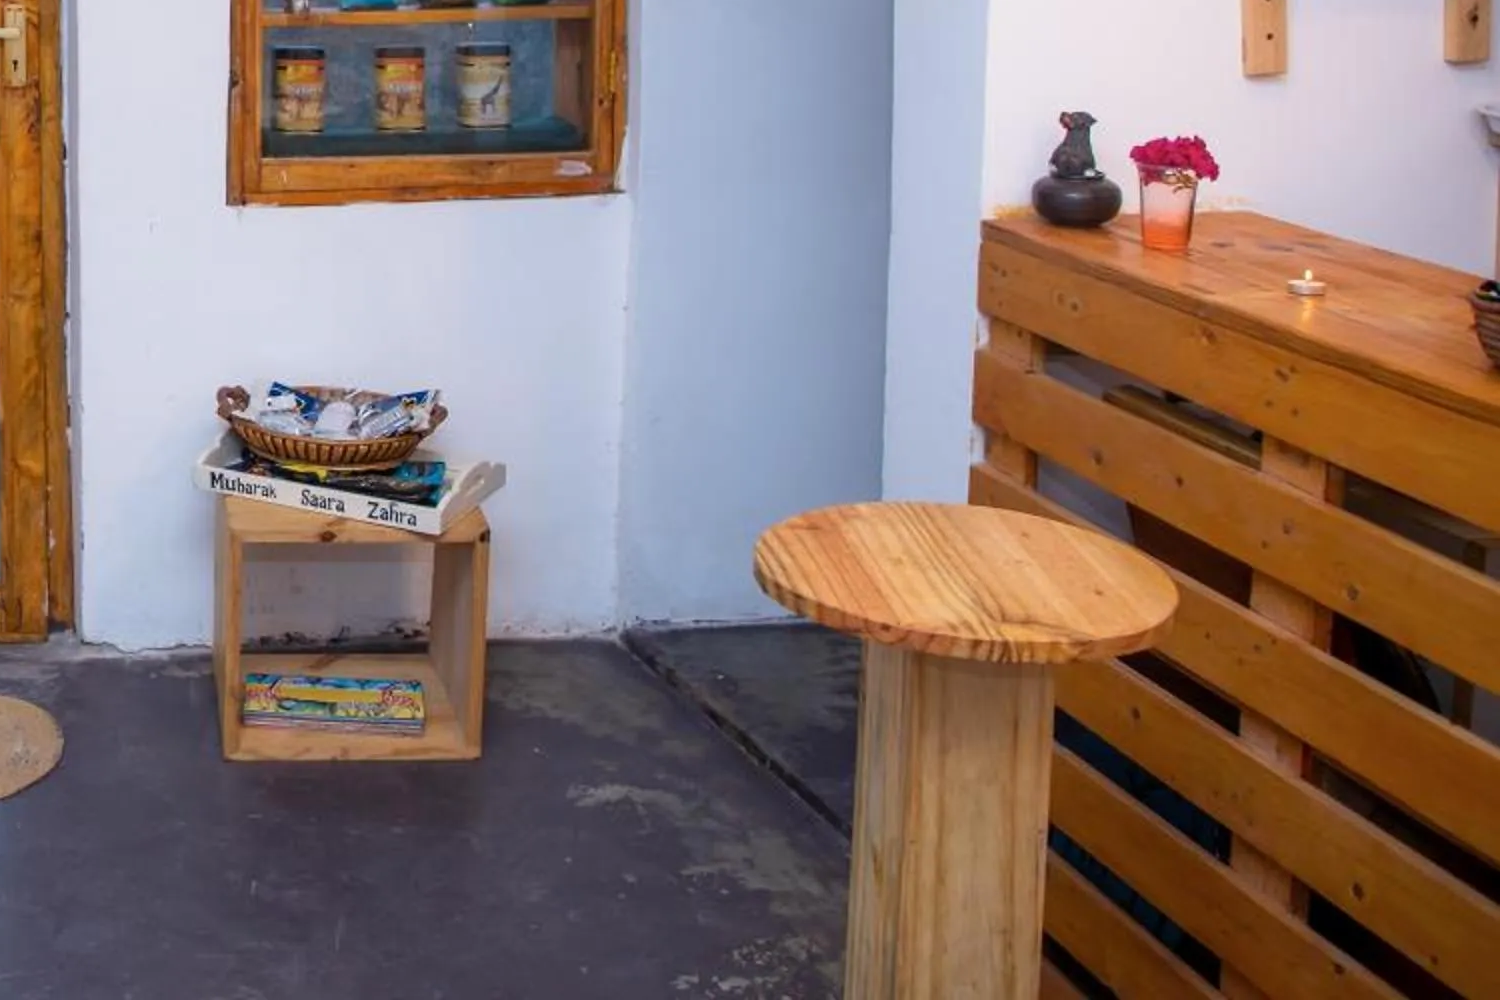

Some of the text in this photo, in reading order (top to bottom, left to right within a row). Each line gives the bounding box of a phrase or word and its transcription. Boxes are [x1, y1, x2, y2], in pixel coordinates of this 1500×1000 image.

[210, 471, 417, 527] Mubarak Saara Zahra
